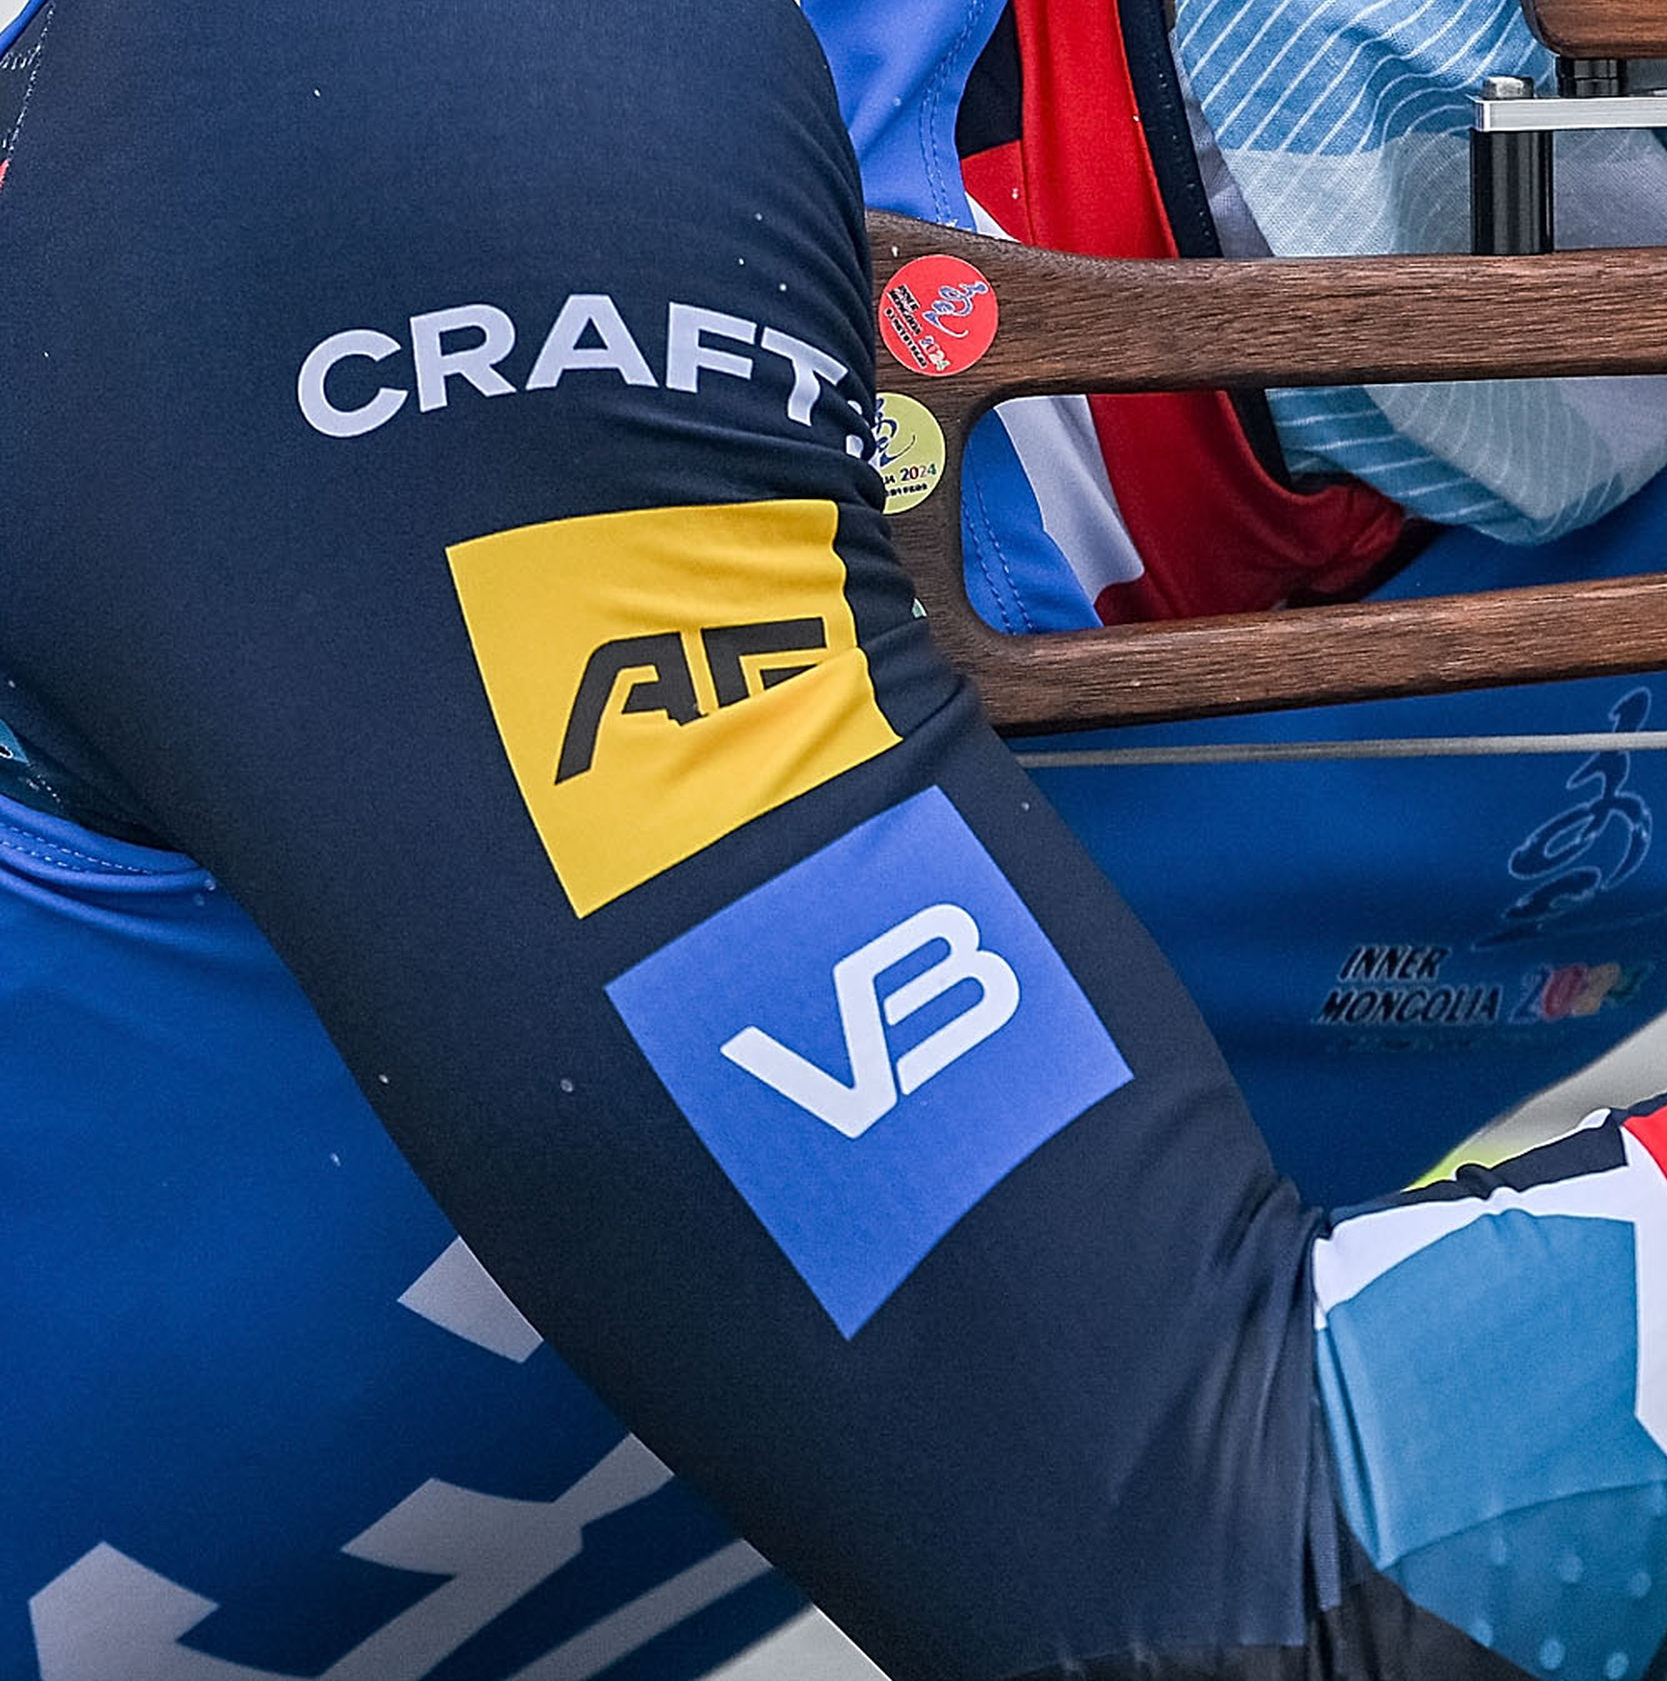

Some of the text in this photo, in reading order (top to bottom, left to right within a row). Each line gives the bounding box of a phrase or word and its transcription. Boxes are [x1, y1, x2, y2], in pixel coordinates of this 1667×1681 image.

[297, 294, 849, 438] CRAFT
[900, 463, 937, 482] 2024
[1338, 945, 1448, 982] INNER
[720, 903, 1020, 1139] VB
